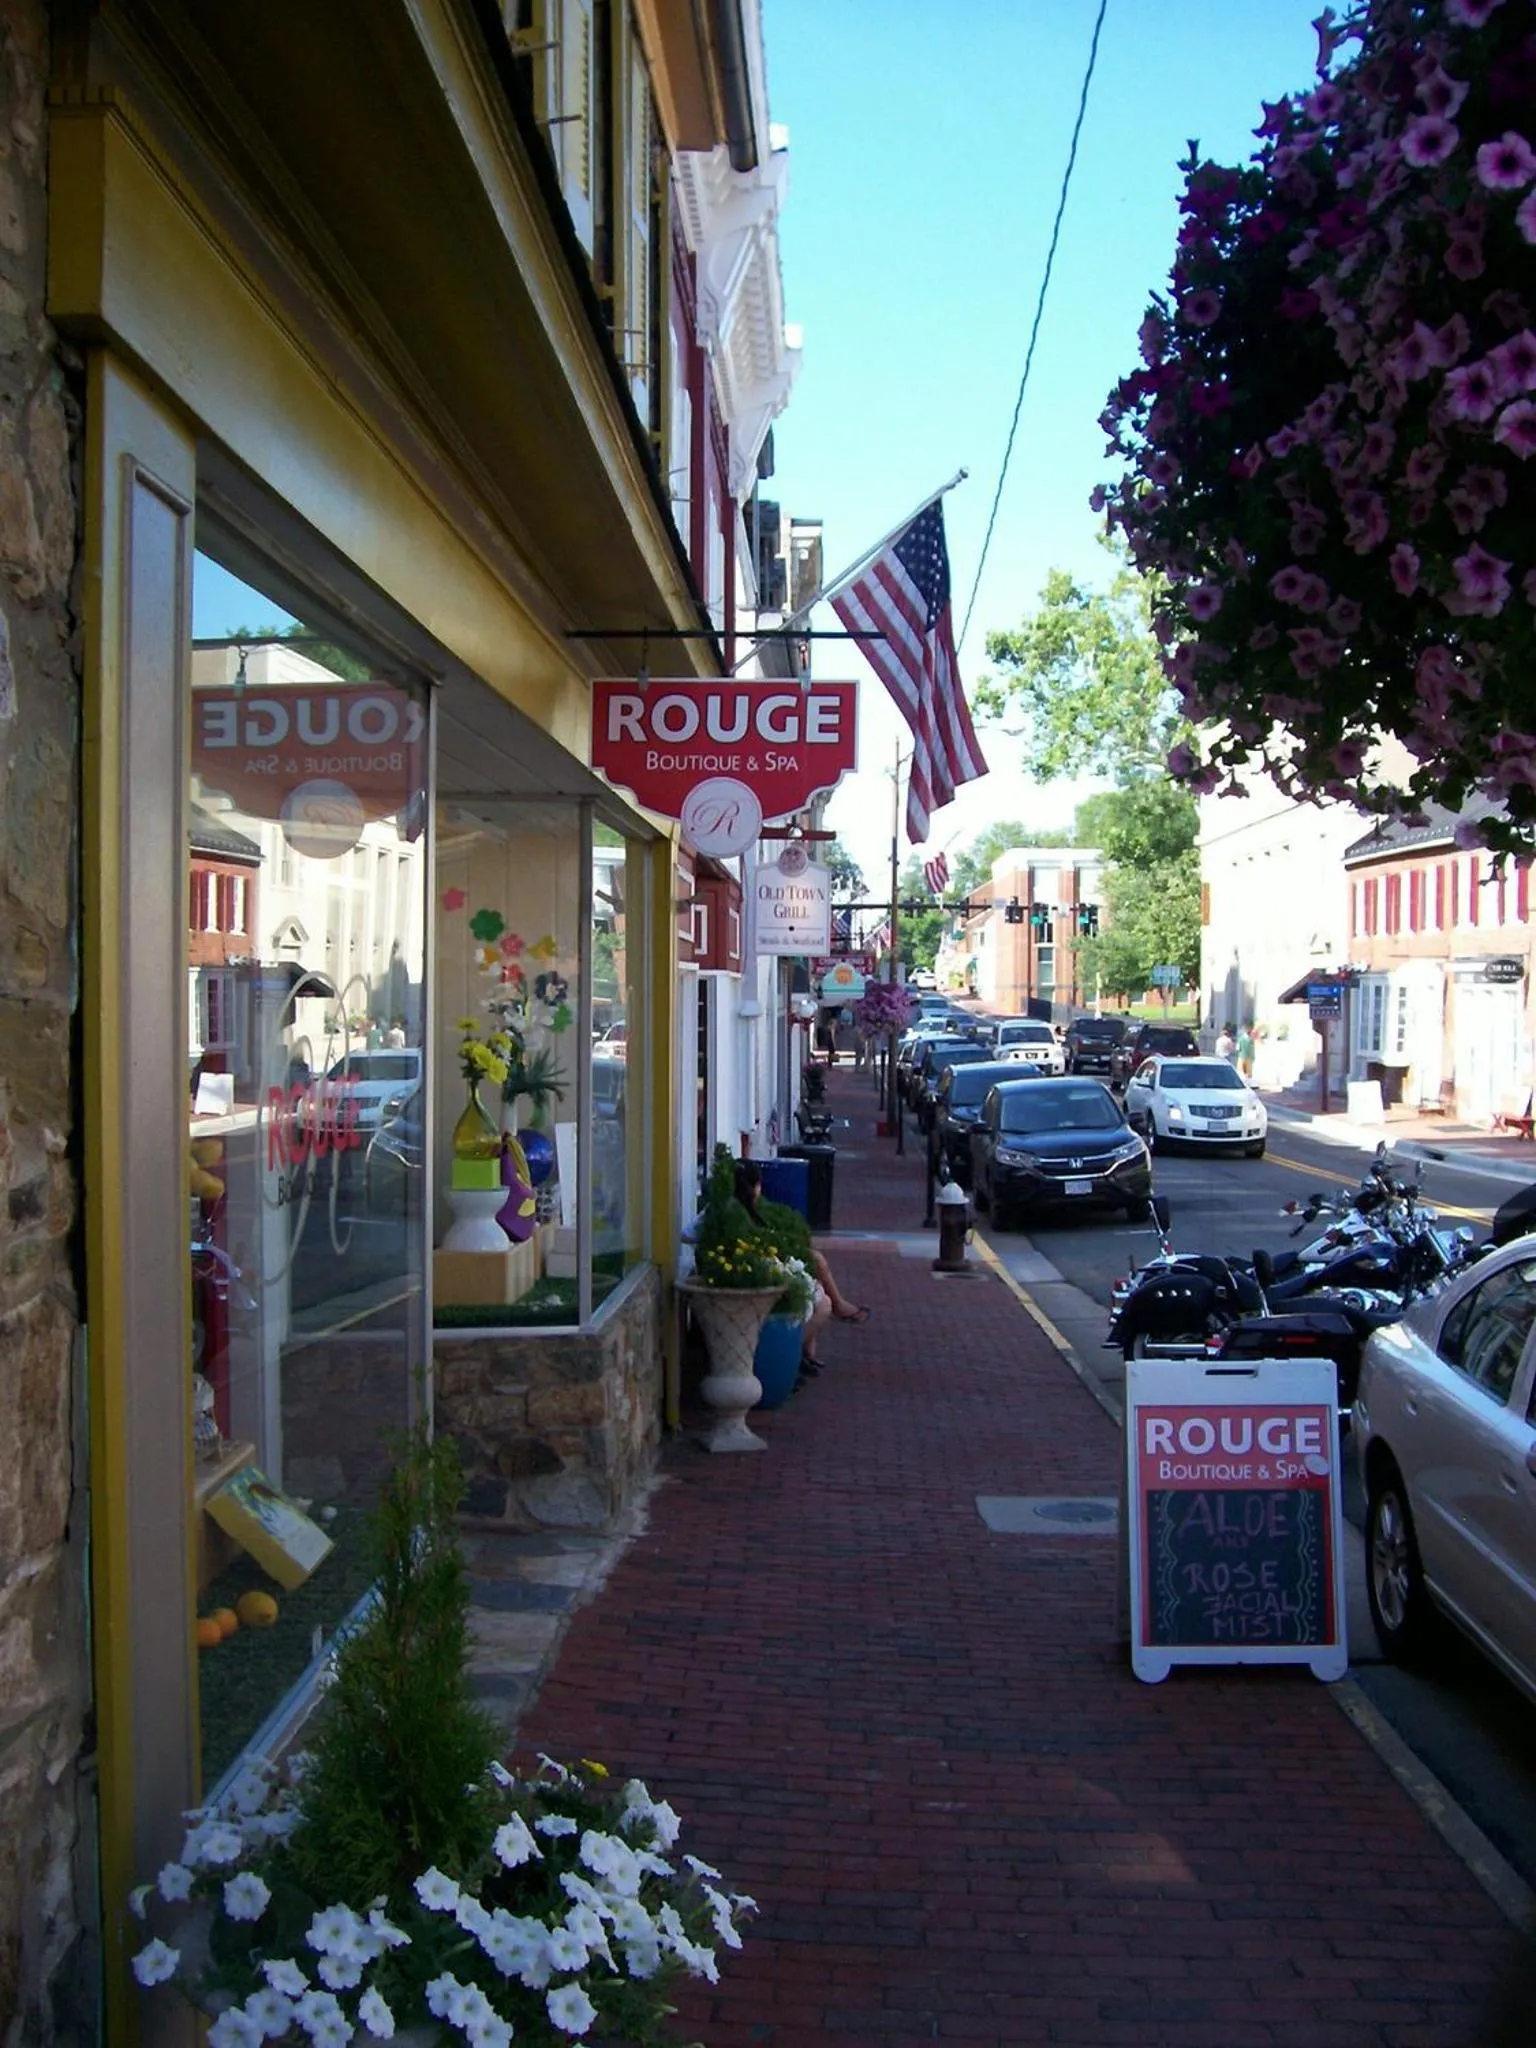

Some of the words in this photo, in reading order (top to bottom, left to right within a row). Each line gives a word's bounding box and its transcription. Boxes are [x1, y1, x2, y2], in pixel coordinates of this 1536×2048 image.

[608, 694, 841, 744] ROUGE
[646, 751, 740, 772] BOUTIQUE
[746, 757, 759, 772] &
[765, 751, 798, 771] SPA
[758, 886, 785, 900] OLD
[787, 885, 825, 900] TOWN
[773, 903, 810, 919] GRILL
[1145, 1418, 1321, 1455] ROUGE
[1159, 1460, 1252, 1480] BOUTIQUE
[1257, 1465, 1271, 1480] &
[1276, 1460, 1309, 1480] SPA
[1177, 1493, 1290, 1538] ALOE
[1182, 1560, 1279, 1593] ROSE
[1212, 1612, 1289, 1638] MIST
